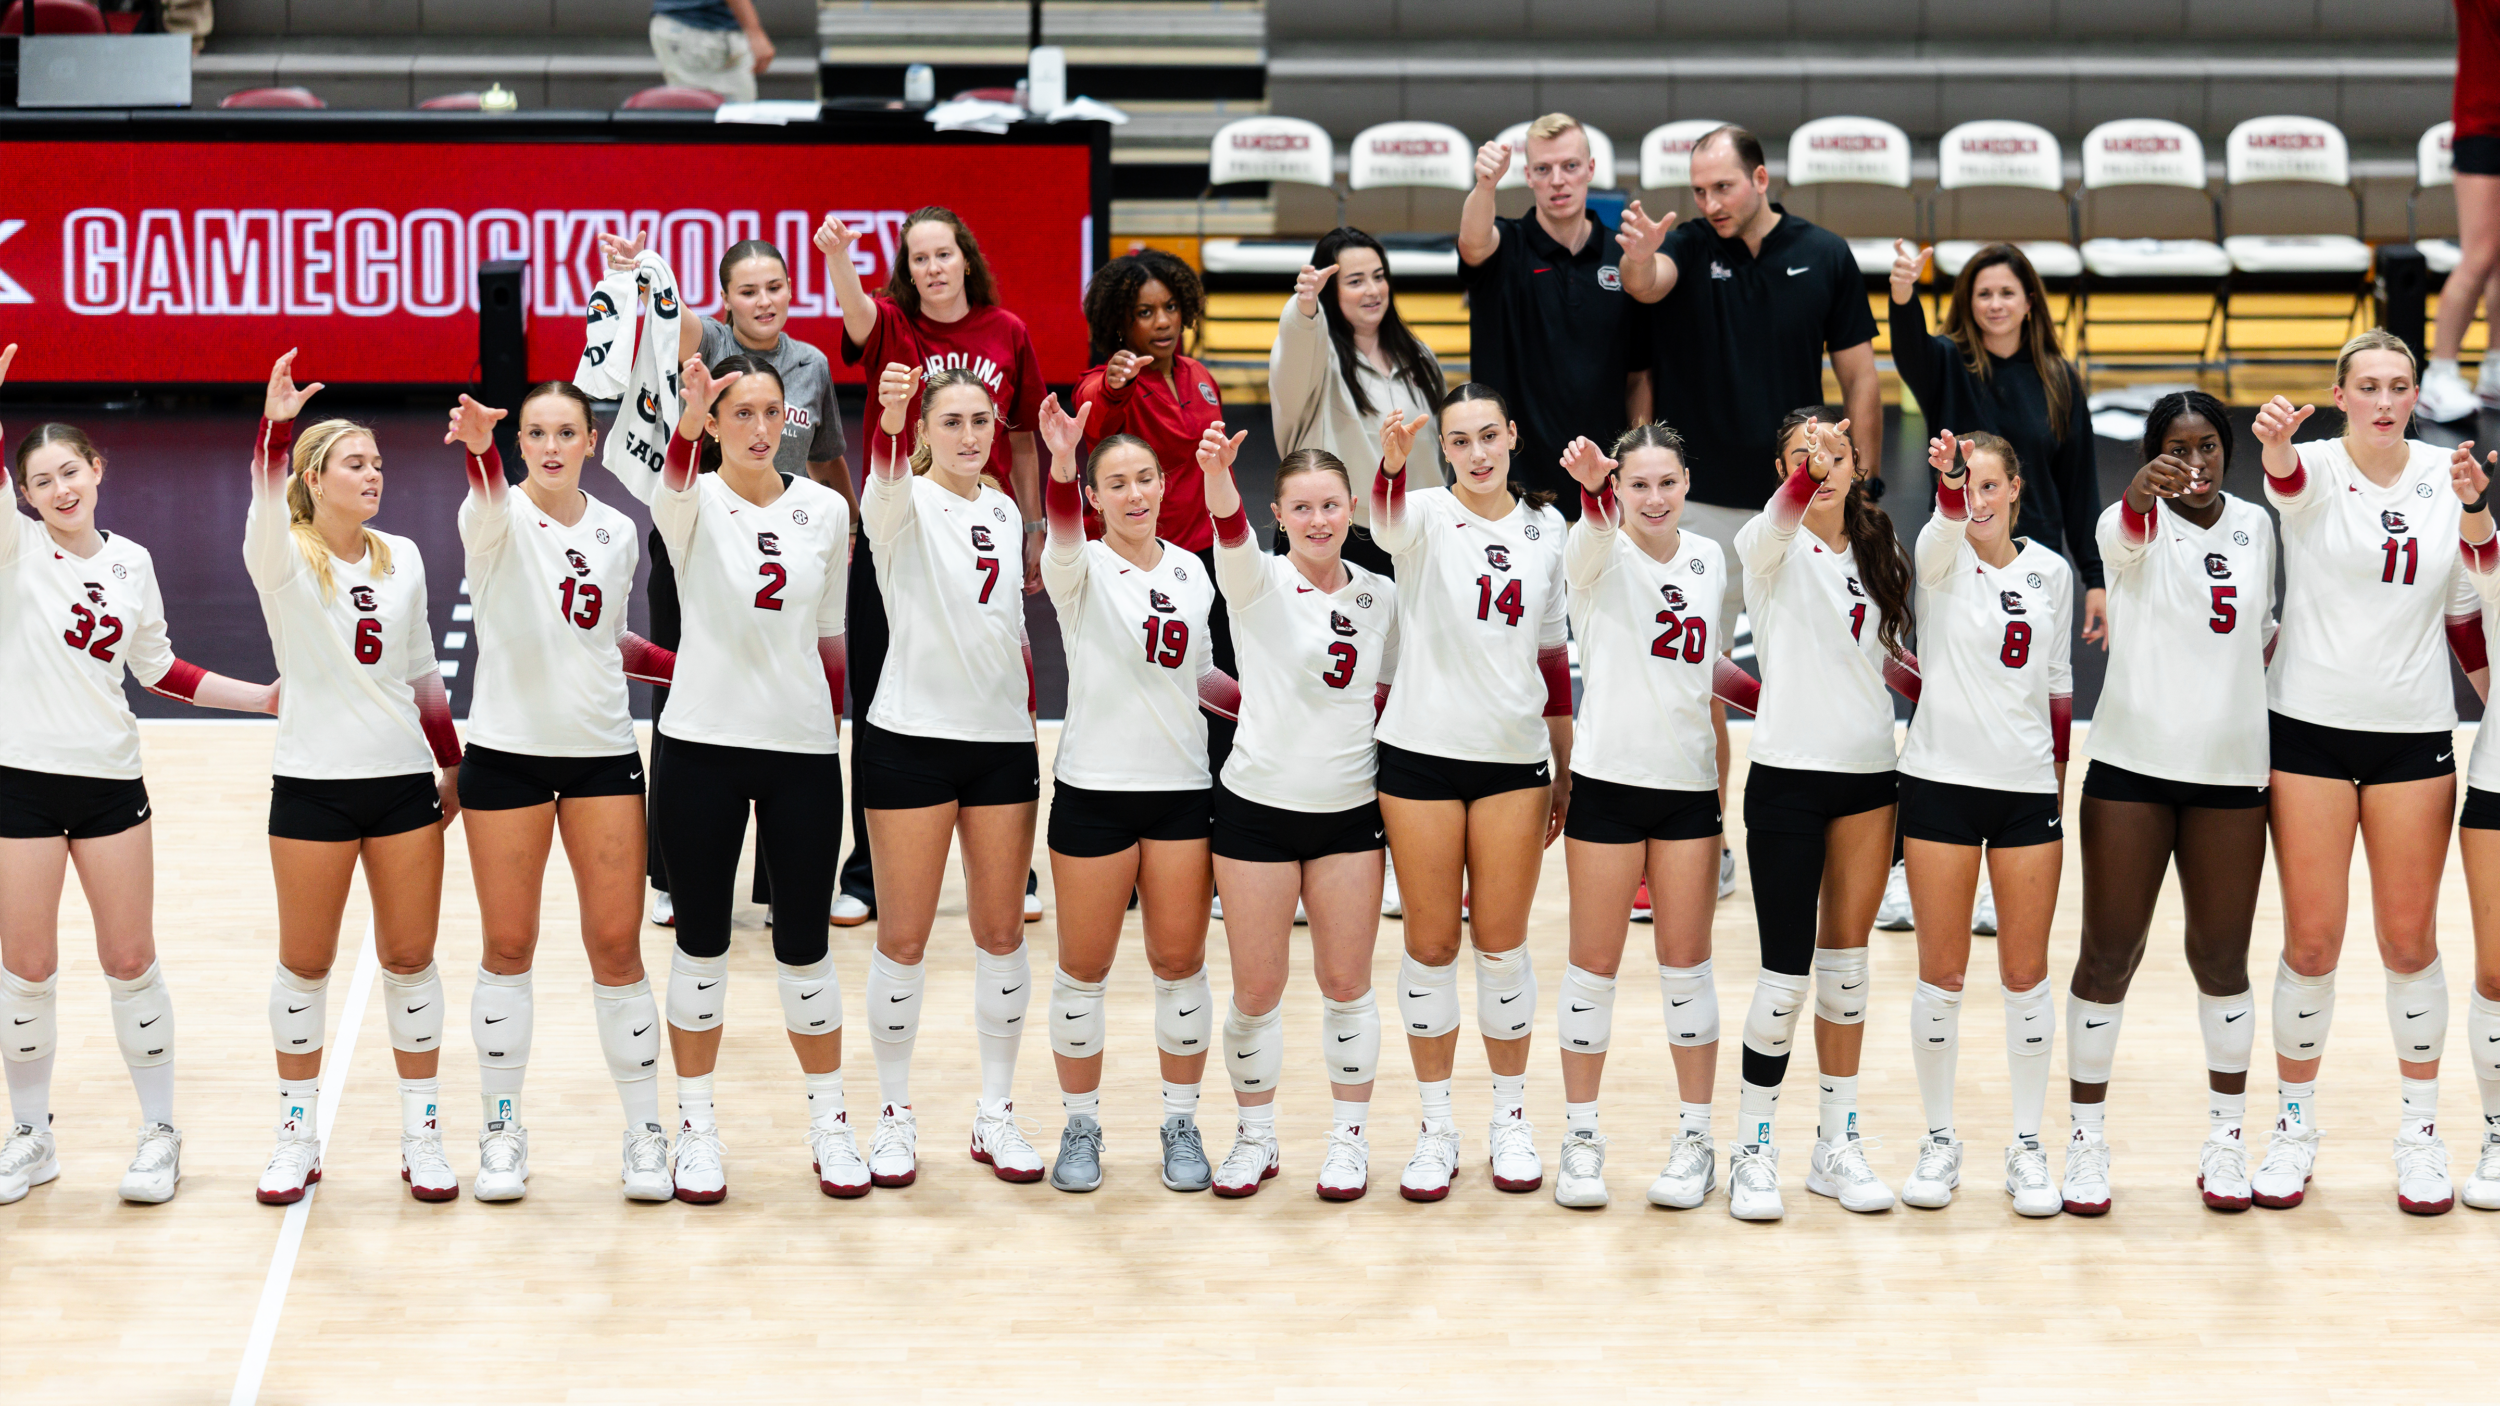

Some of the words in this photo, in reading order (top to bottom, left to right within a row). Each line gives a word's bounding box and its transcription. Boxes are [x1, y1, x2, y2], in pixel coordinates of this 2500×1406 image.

[922, 352, 1003, 394] ROINA
[1525, 525, 1540, 540] SEC
[976, 557, 1000, 604] 7
[2381, 536, 2418, 586] 11
[558, 576, 602, 630] 13
[754, 562, 787, 611] 2
[1356, 593, 1372, 608] SEC
[1476, 574, 1524, 626] 14
[2209, 586, 2237, 634] 5
[64, 603, 123, 663] 32
[354, 618, 382, 665] 6
[1142, 615, 1190, 670] 19
[1650, 610, 1707, 664] 20
[1849, 602, 1868, 646] 1
[2000, 620, 2032, 669] 8
[1322, 640, 1358, 689] 3
